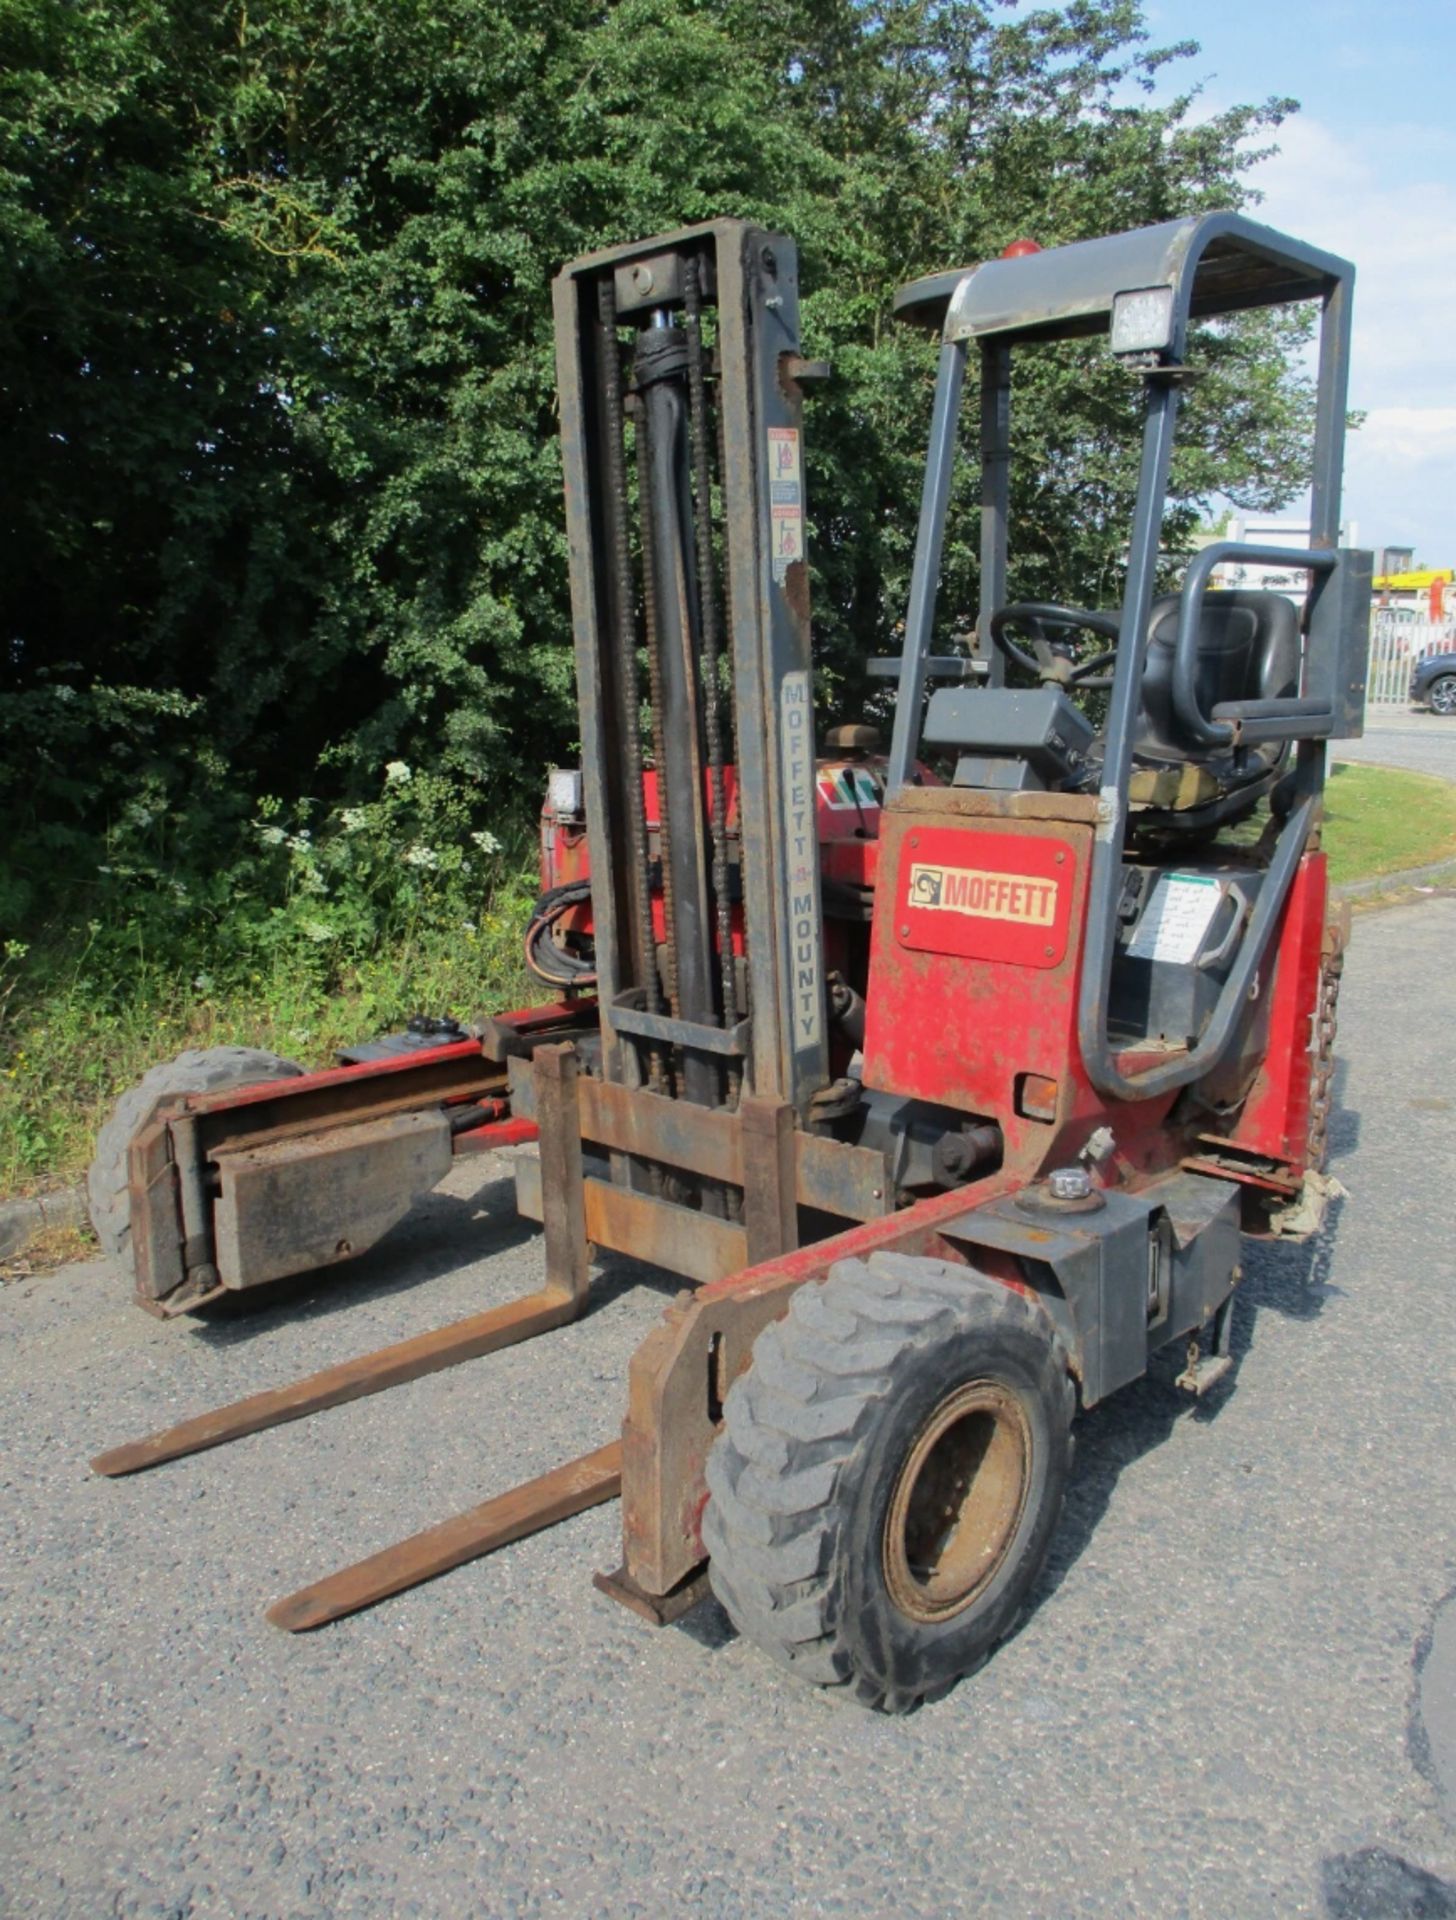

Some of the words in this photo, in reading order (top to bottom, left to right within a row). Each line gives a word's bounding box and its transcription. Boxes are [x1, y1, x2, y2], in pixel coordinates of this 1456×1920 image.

[785, 683, 806, 856] MOFFETT
[794, 893, 814, 1036] MOUNTY
[944, 874, 1054, 919] MOFFETT
